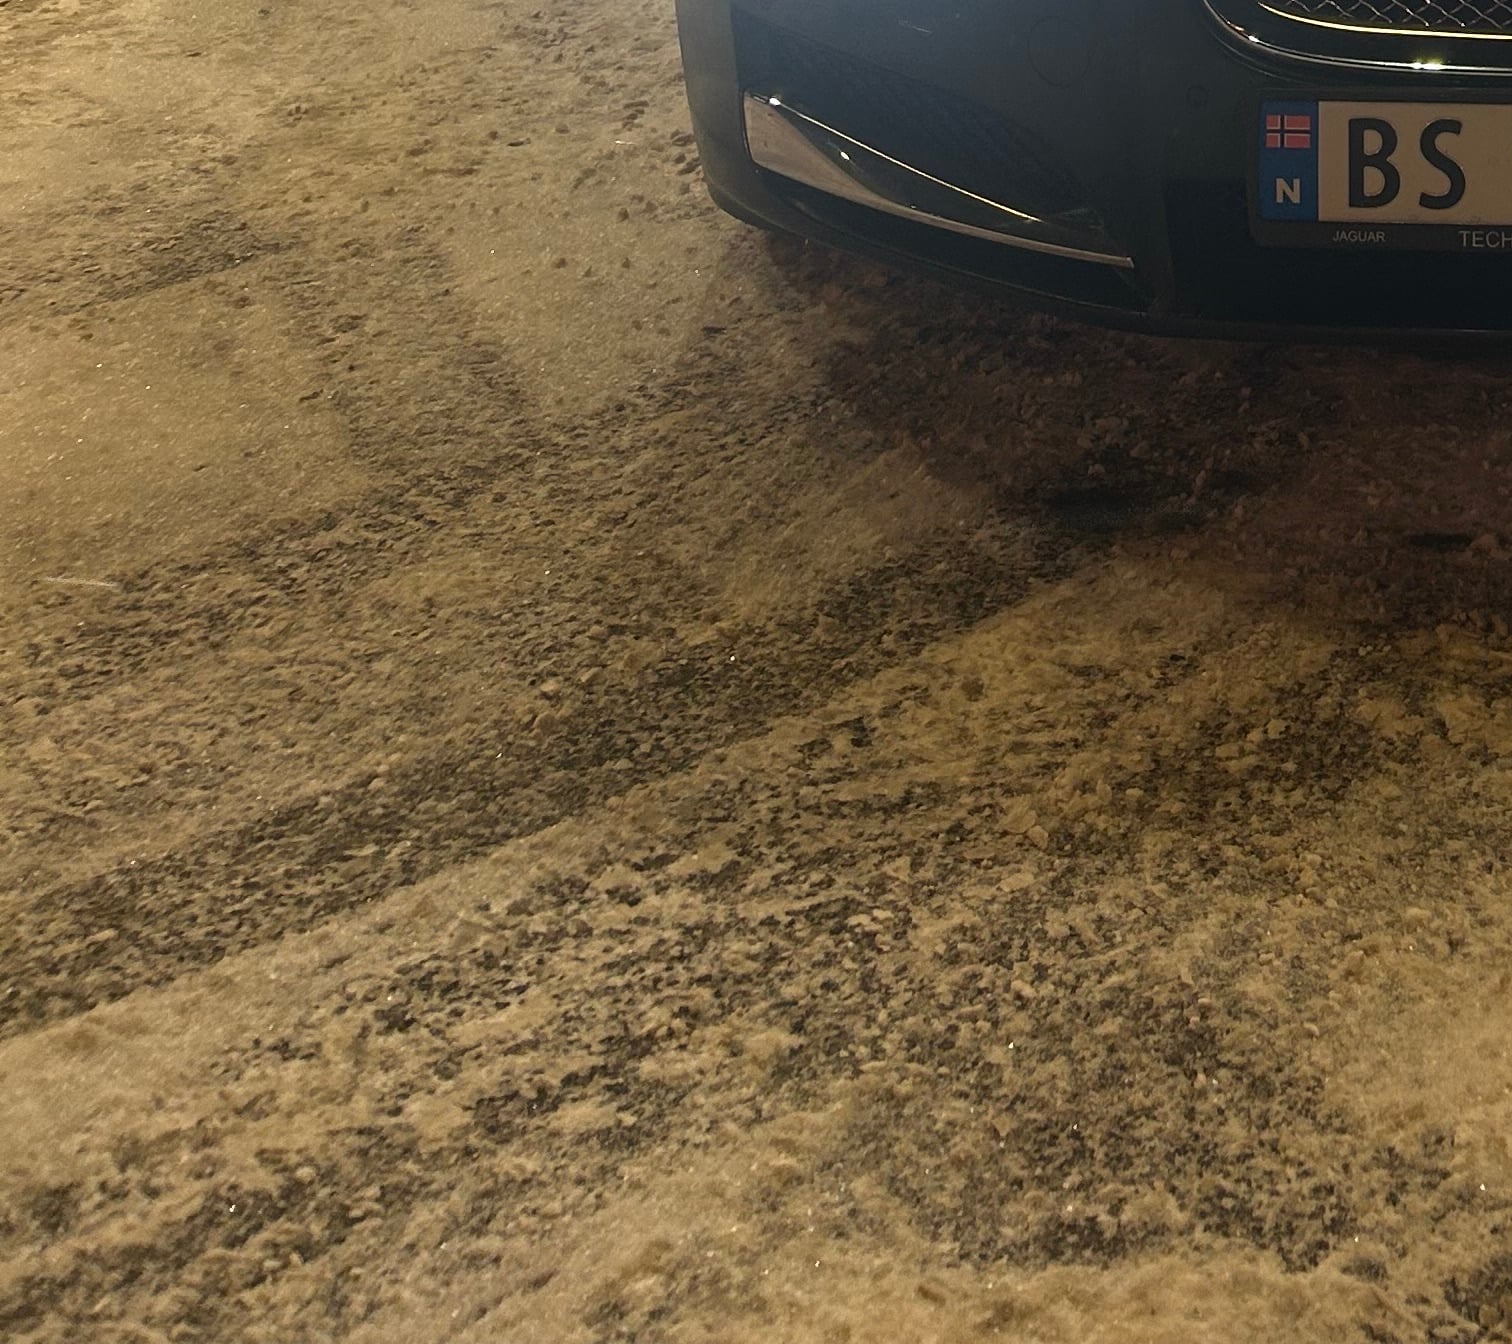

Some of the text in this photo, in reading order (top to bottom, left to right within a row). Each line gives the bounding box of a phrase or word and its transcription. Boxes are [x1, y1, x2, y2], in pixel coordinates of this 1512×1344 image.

[1347, 117, 1467, 210] BS
[1274, 177, 1301, 204] N
[1332, 230, 1386, 243] JAGUAR
